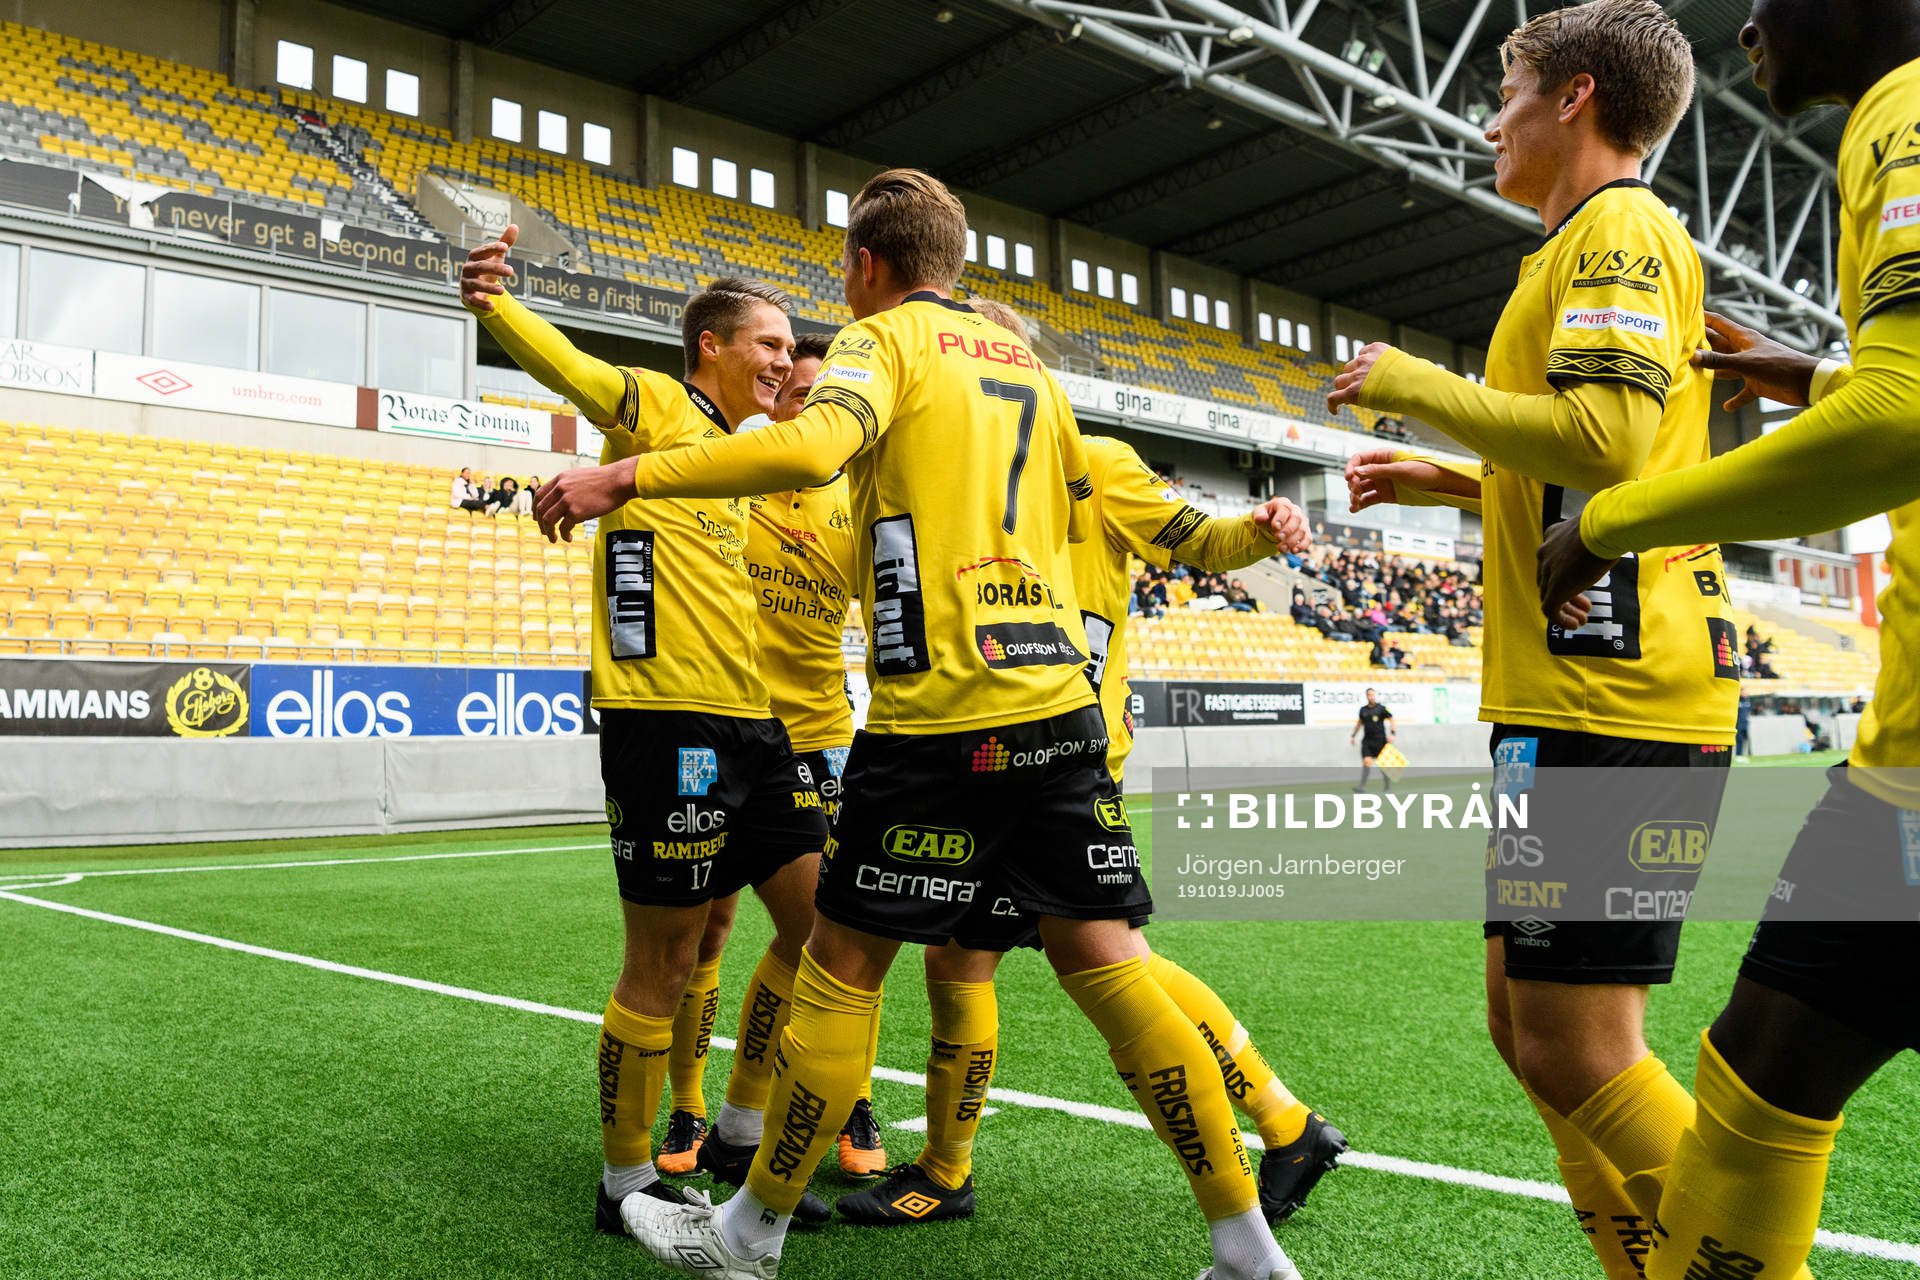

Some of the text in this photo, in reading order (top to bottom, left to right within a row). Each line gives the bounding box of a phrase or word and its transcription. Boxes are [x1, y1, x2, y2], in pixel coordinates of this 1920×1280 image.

[171, 205, 246, 236] never
[254, 222, 294, 246] get
[303, 231, 316, 249] a
[326, 238, 406, 267] second
[526, 275, 581, 300] make
[587, 287, 599, 304] a
[605, 286, 643, 312] first
[1578, 250, 1663, 278] V/S/B
[1579, 312, 1661, 333] INTERSPORT
[232, 384, 323, 407] umbro.com
[451, 404, 531, 437] Tidning
[979, 377, 1038, 535] 7
[609, 540, 652, 625] input
[761, 588, 843, 625] Sjuhärad
[873, 556, 916, 667] input
[266, 670, 413, 737] ellos
[457, 672, 584, 736] ellos
[1170, 689, 1204, 724] FR
[682, 764, 715, 780] EKT
[683, 751, 710, 765] EFF
[667, 803, 726, 834] ellos
[891, 829, 967, 859] EAB
[1638, 829, 1706, 865] EAB
[690, 860, 713, 890] 17
[856, 864, 976, 903] Cernera
[1097, 871, 1133, 885] umbro
[1514, 935, 1551, 948] umbro
[694, 986, 720, 1060] FRISTADS
[743, 983, 784, 1066] RISTADS
[956, 1049, 994, 1123] FRISTADS
[768, 1080, 827, 1186] FRISTADS
[1149, 1064, 1215, 1178] FRISTADS
[1230, 1127, 1252, 1177] umbro
